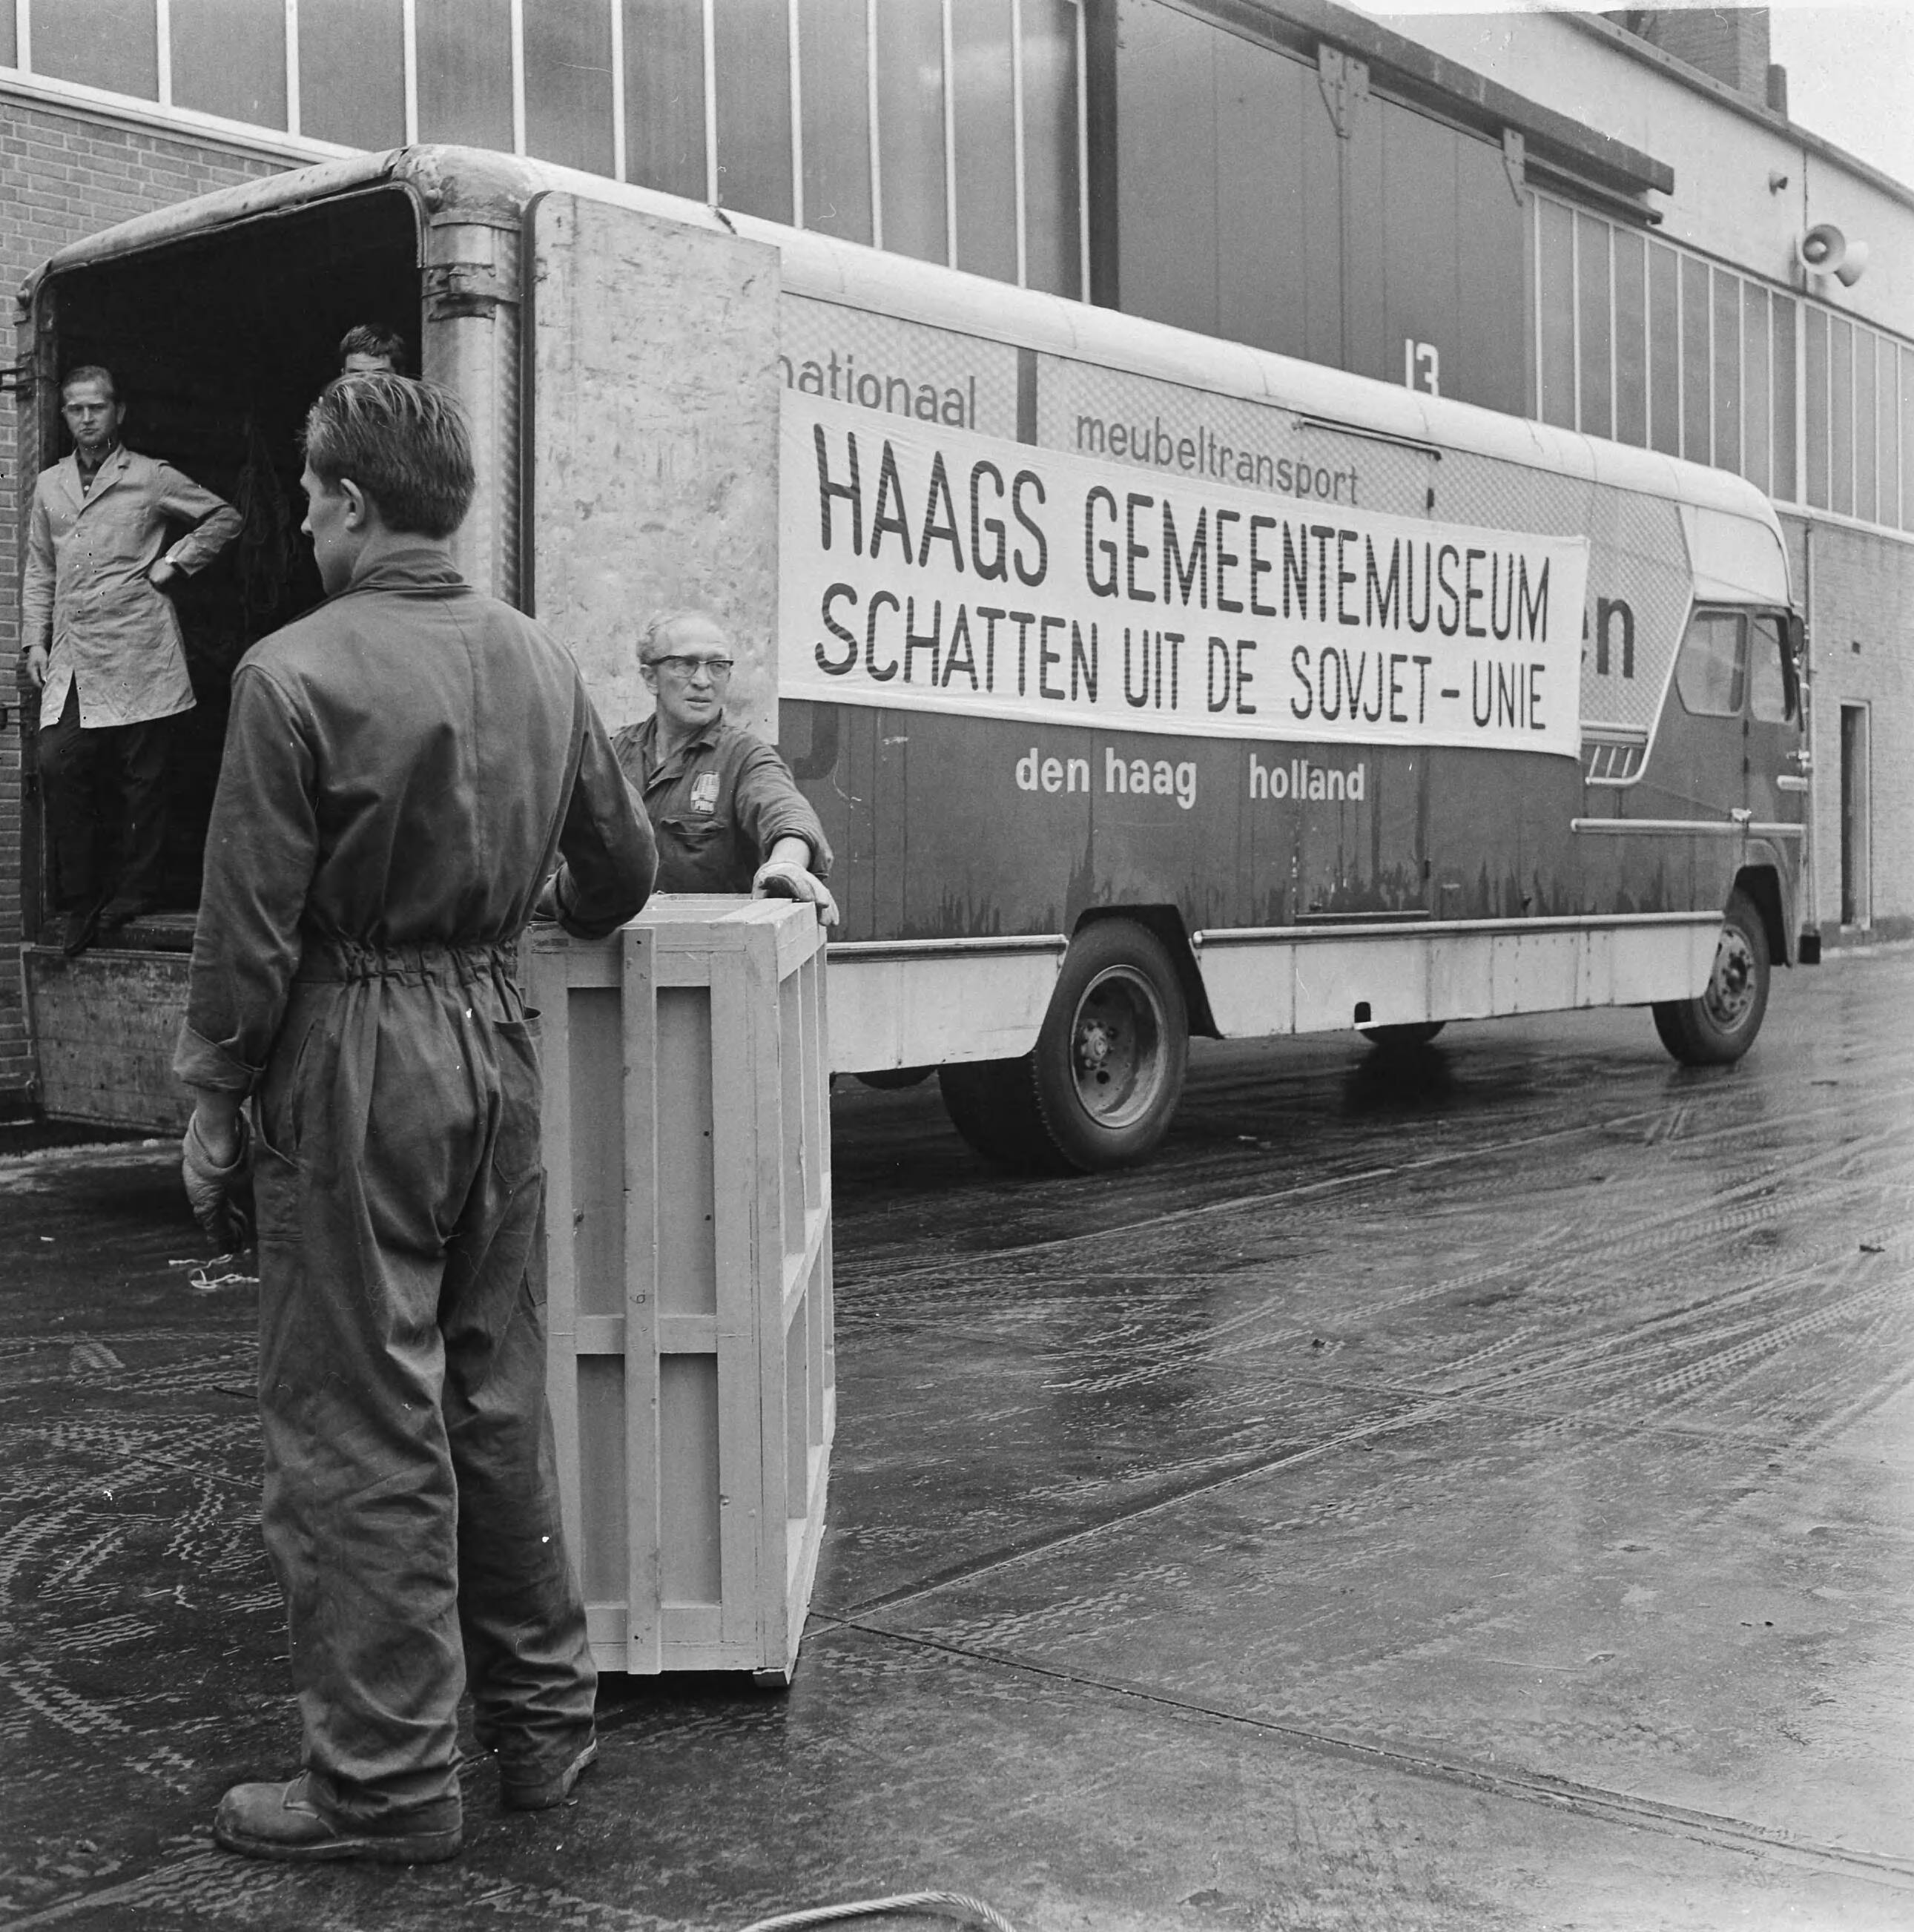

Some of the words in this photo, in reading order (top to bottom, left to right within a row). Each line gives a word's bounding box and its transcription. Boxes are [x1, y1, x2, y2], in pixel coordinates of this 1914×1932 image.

[1405, 338, 1439, 396] 13
[1077, 415, 1358, 504] meubeltransport
[814, 423, 1048, 587] HAAGS
[1085, 486, 1550, 642] GEMEENTEMUSEUM
[815, 582, 1098, 703] SCHATTEN
[1124, 627, 1185, 711] UIT
[1207, 636, 1257, 714] DE
[1581, 596, 1634, 679] n
[1015, 748, 1089, 793] den
[1106, 747, 1197, 810] haag
[1250, 754, 1365, 801] holland
